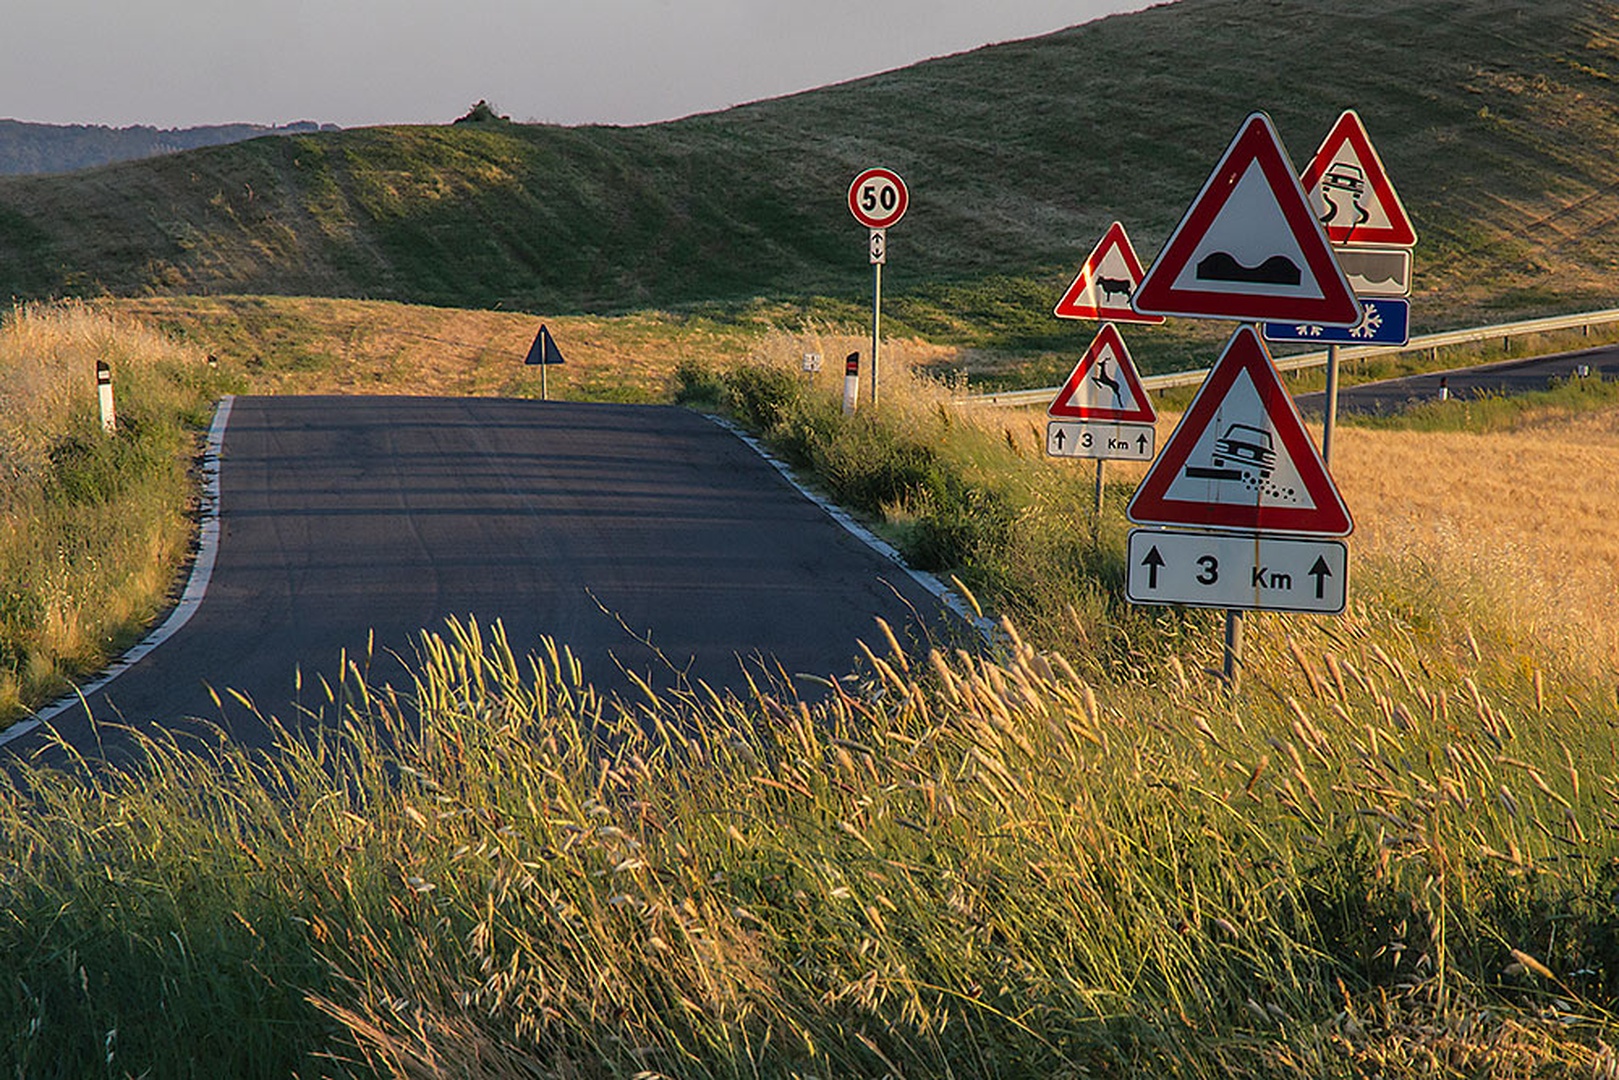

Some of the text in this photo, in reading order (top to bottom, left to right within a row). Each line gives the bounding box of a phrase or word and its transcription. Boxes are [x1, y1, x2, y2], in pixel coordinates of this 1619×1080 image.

[862, 185, 896, 211] 50
[1081, 433, 1129, 450] 3 Km
[1196, 555, 1291, 590] 3 Km
